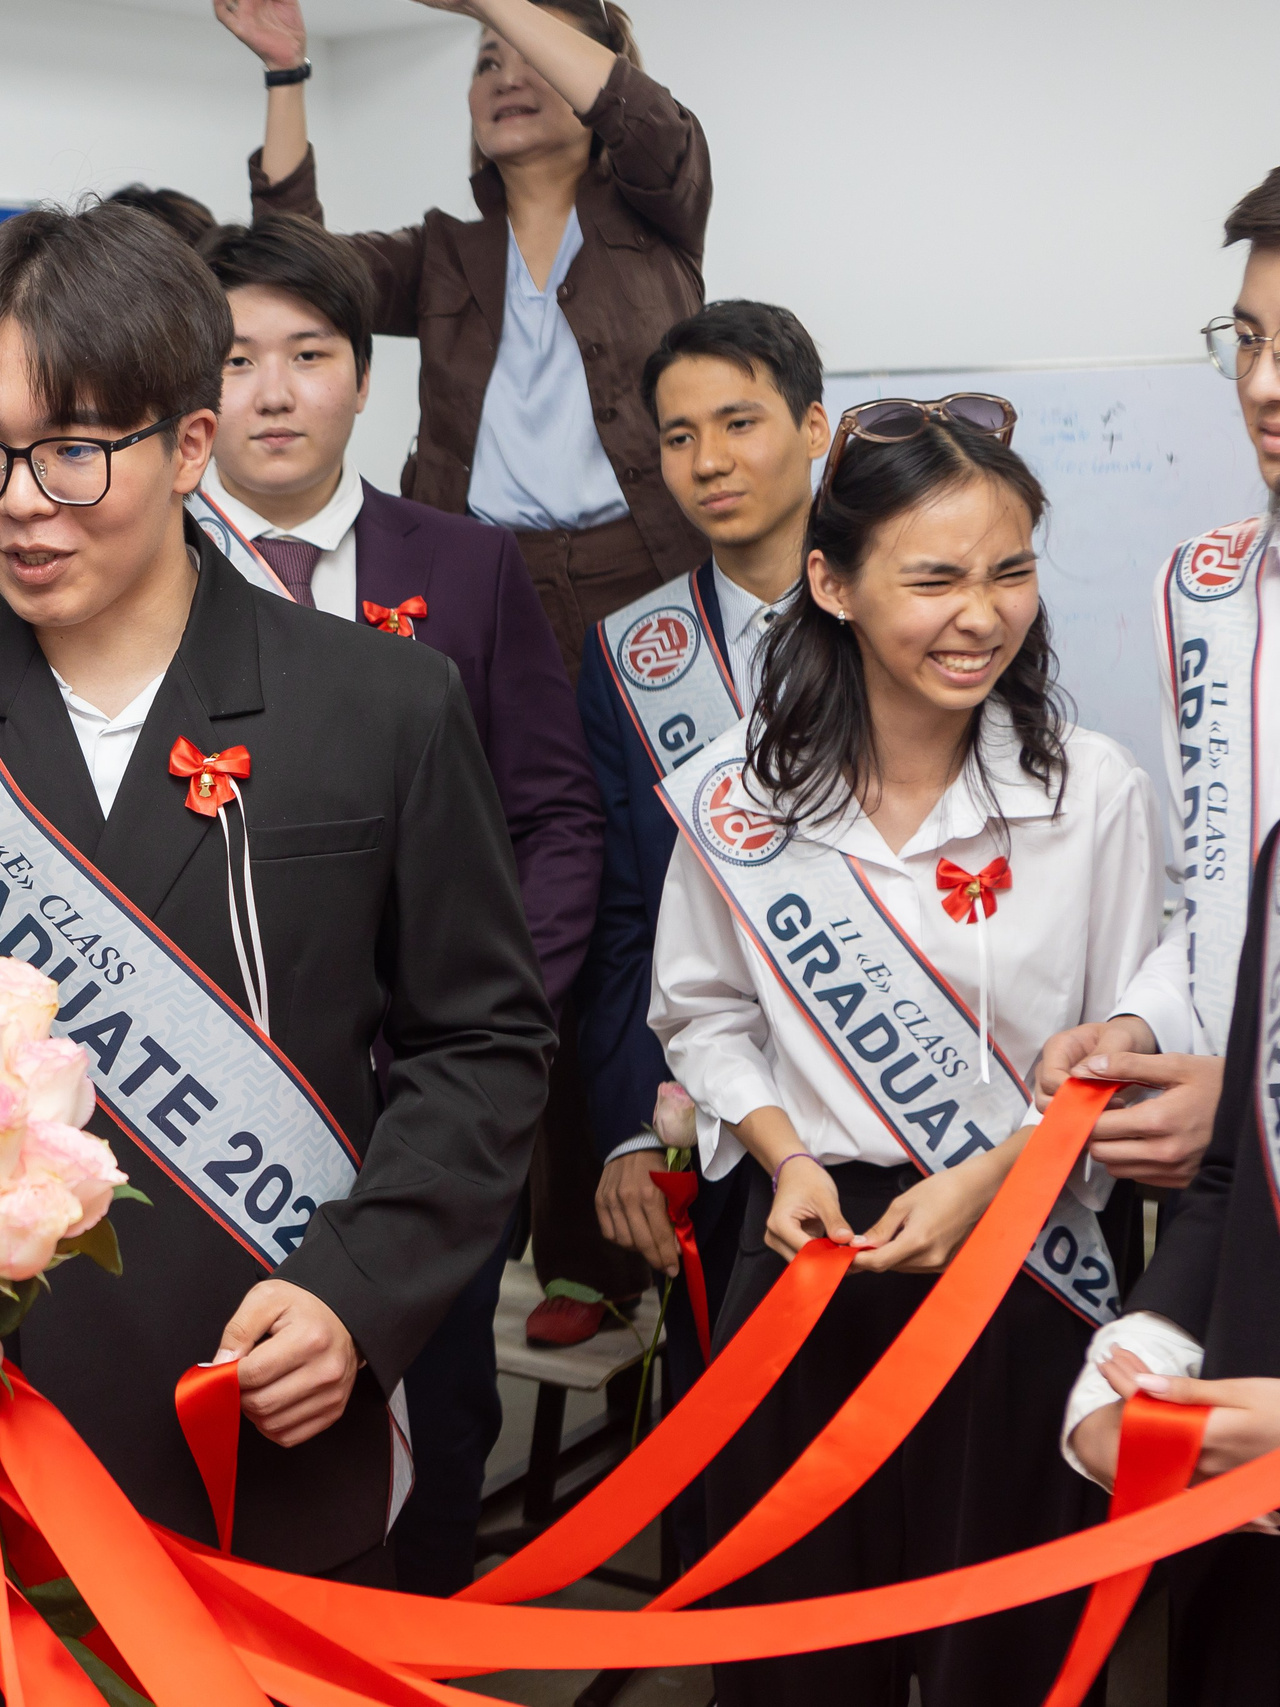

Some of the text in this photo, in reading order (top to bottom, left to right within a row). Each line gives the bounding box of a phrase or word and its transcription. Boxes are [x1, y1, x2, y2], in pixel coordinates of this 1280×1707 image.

[1210, 680, 1229, 706] 11
[1204, 781, 1229, 881] CLASS
[39, 895, 136, 985] CLASS
[829, 916, 863, 946] 11
[893, 999, 969, 1078] CLASS
[1030, 1217, 1120, 1319] 02
